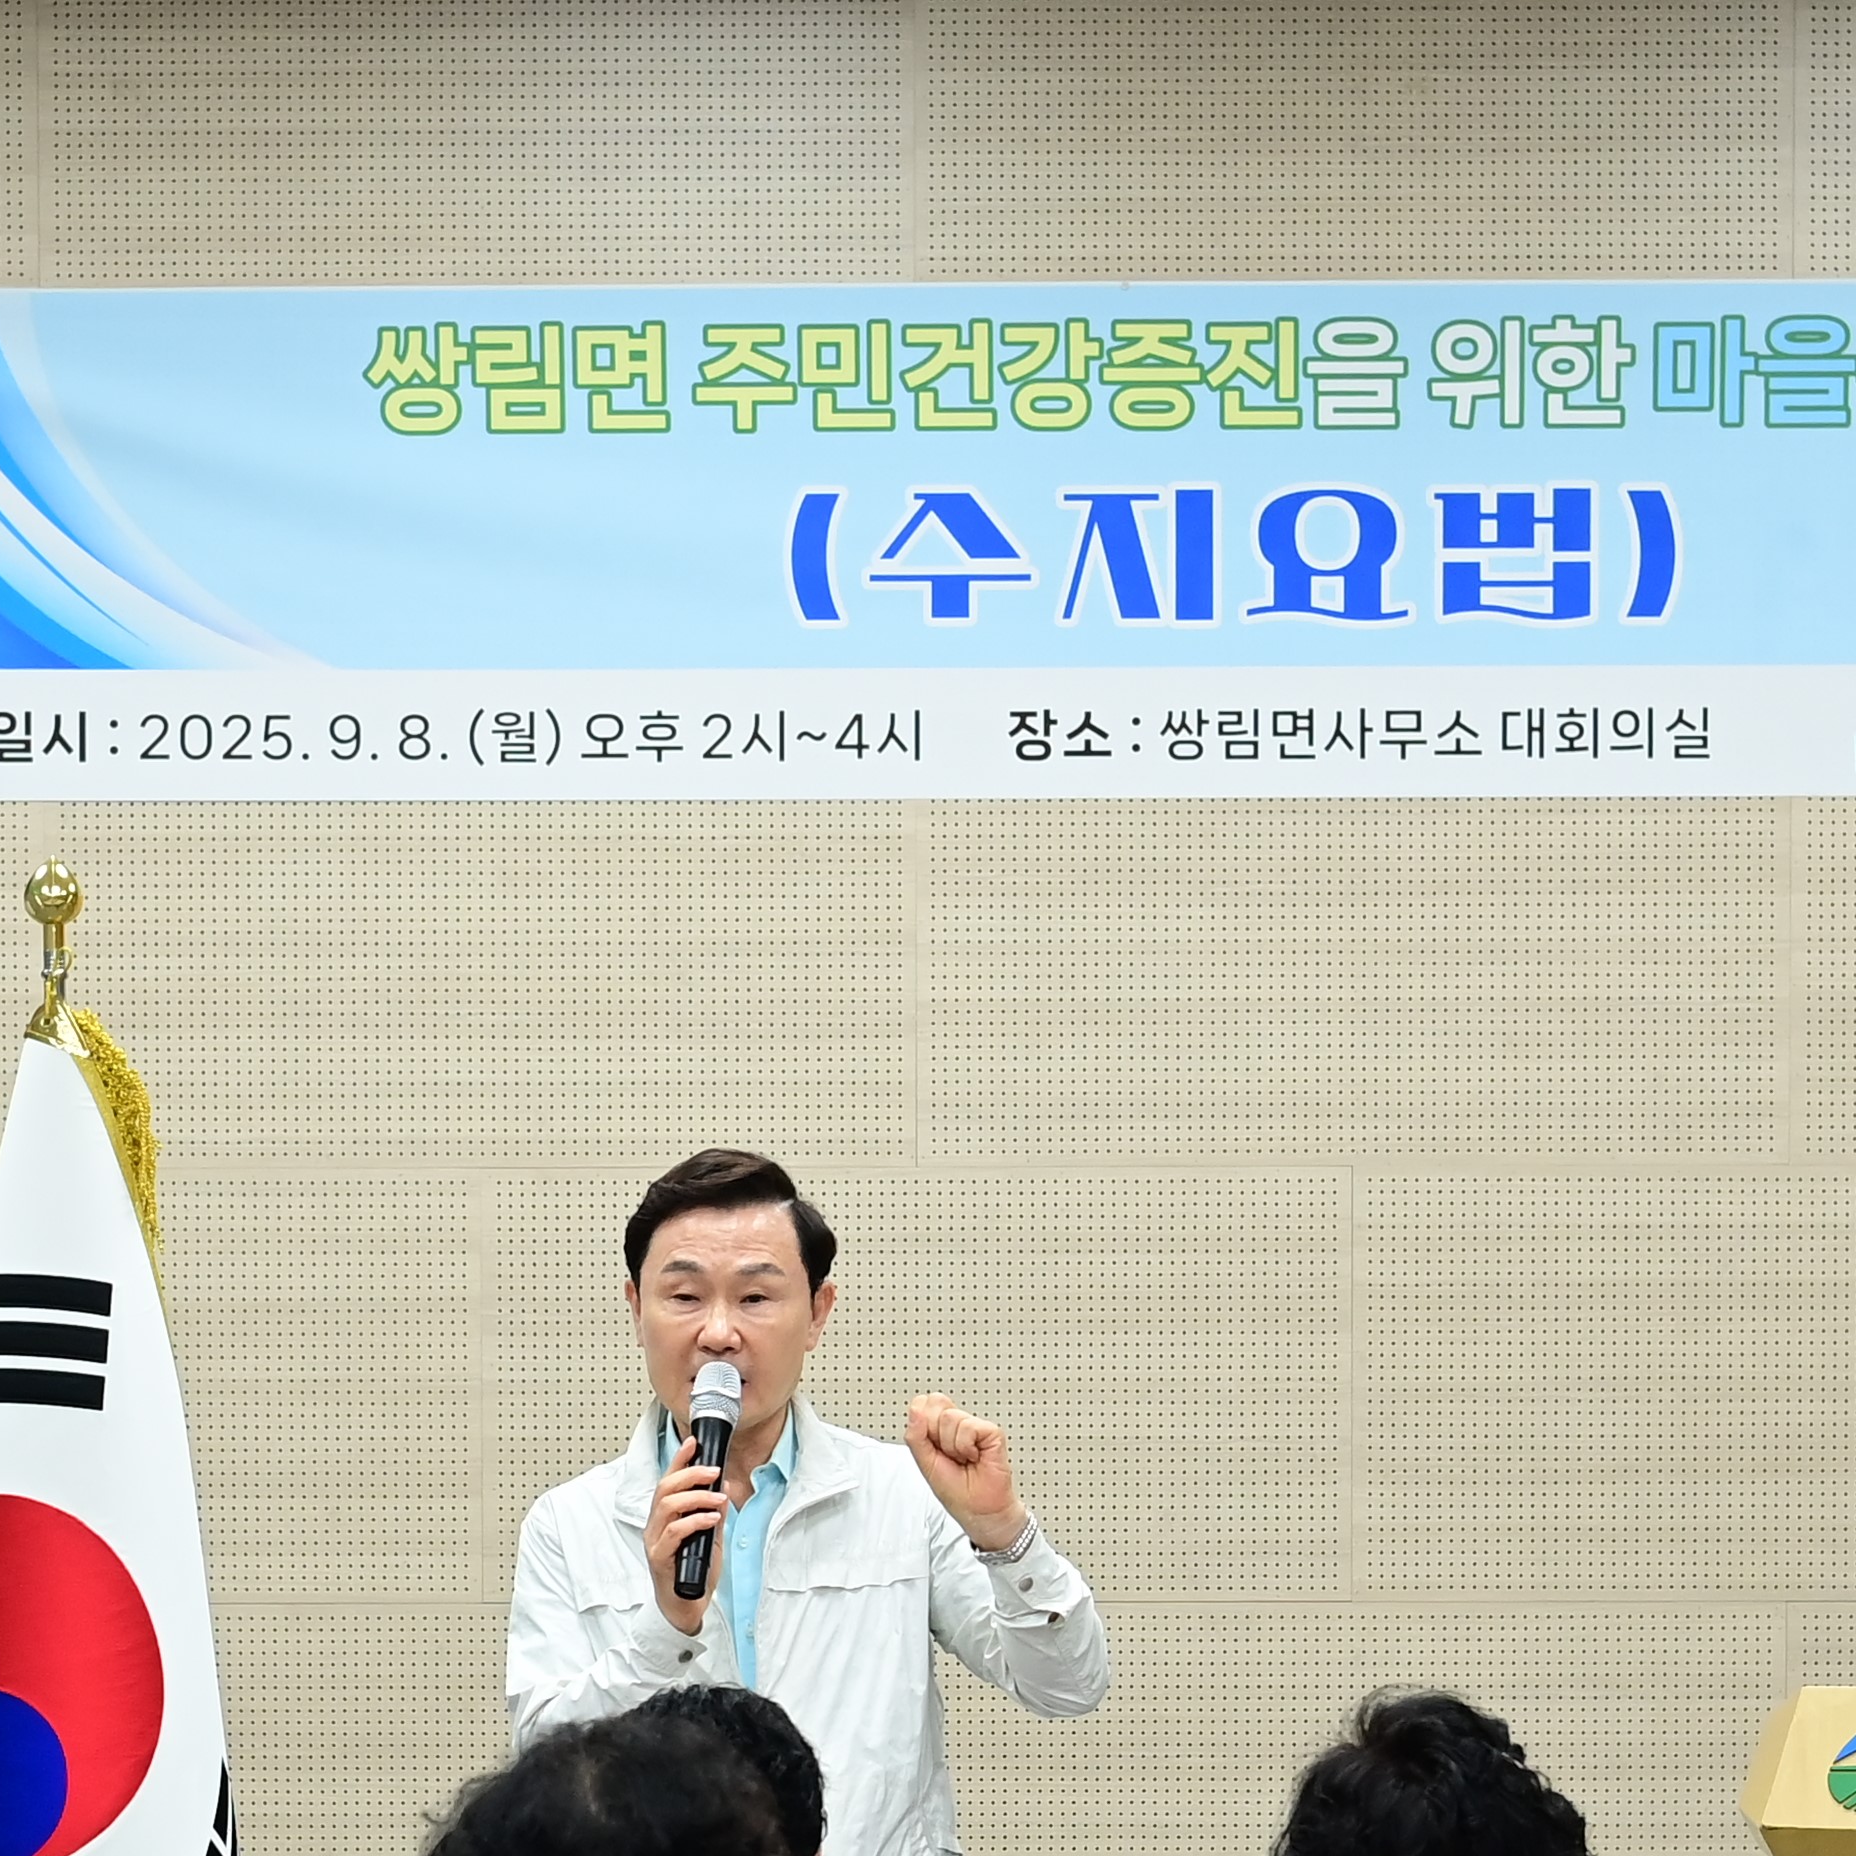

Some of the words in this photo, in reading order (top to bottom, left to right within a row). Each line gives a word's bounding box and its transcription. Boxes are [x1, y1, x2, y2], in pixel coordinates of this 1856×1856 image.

[362, 319, 674, 437] 쌍림면
[691, 315, 1411, 435] 주민건강증진을
[1427, 313, 1639, 431] 위한
[790, 488, 1677, 622] (수지요법)
[139, 714, 310, 761] 2025.
[329, 714, 378, 761] 9.
[398, 714, 448, 761] 8.
[469, 708, 561, 766] (월)
[581, 710, 684, 763] 오후
[702, 709, 921, 762] 2시~4시
[1008, 709, 1112, 761] 장소
[1160, 707, 1484, 761] 쌍림면사무소
[1501, 707, 1710, 760] 대회의실
